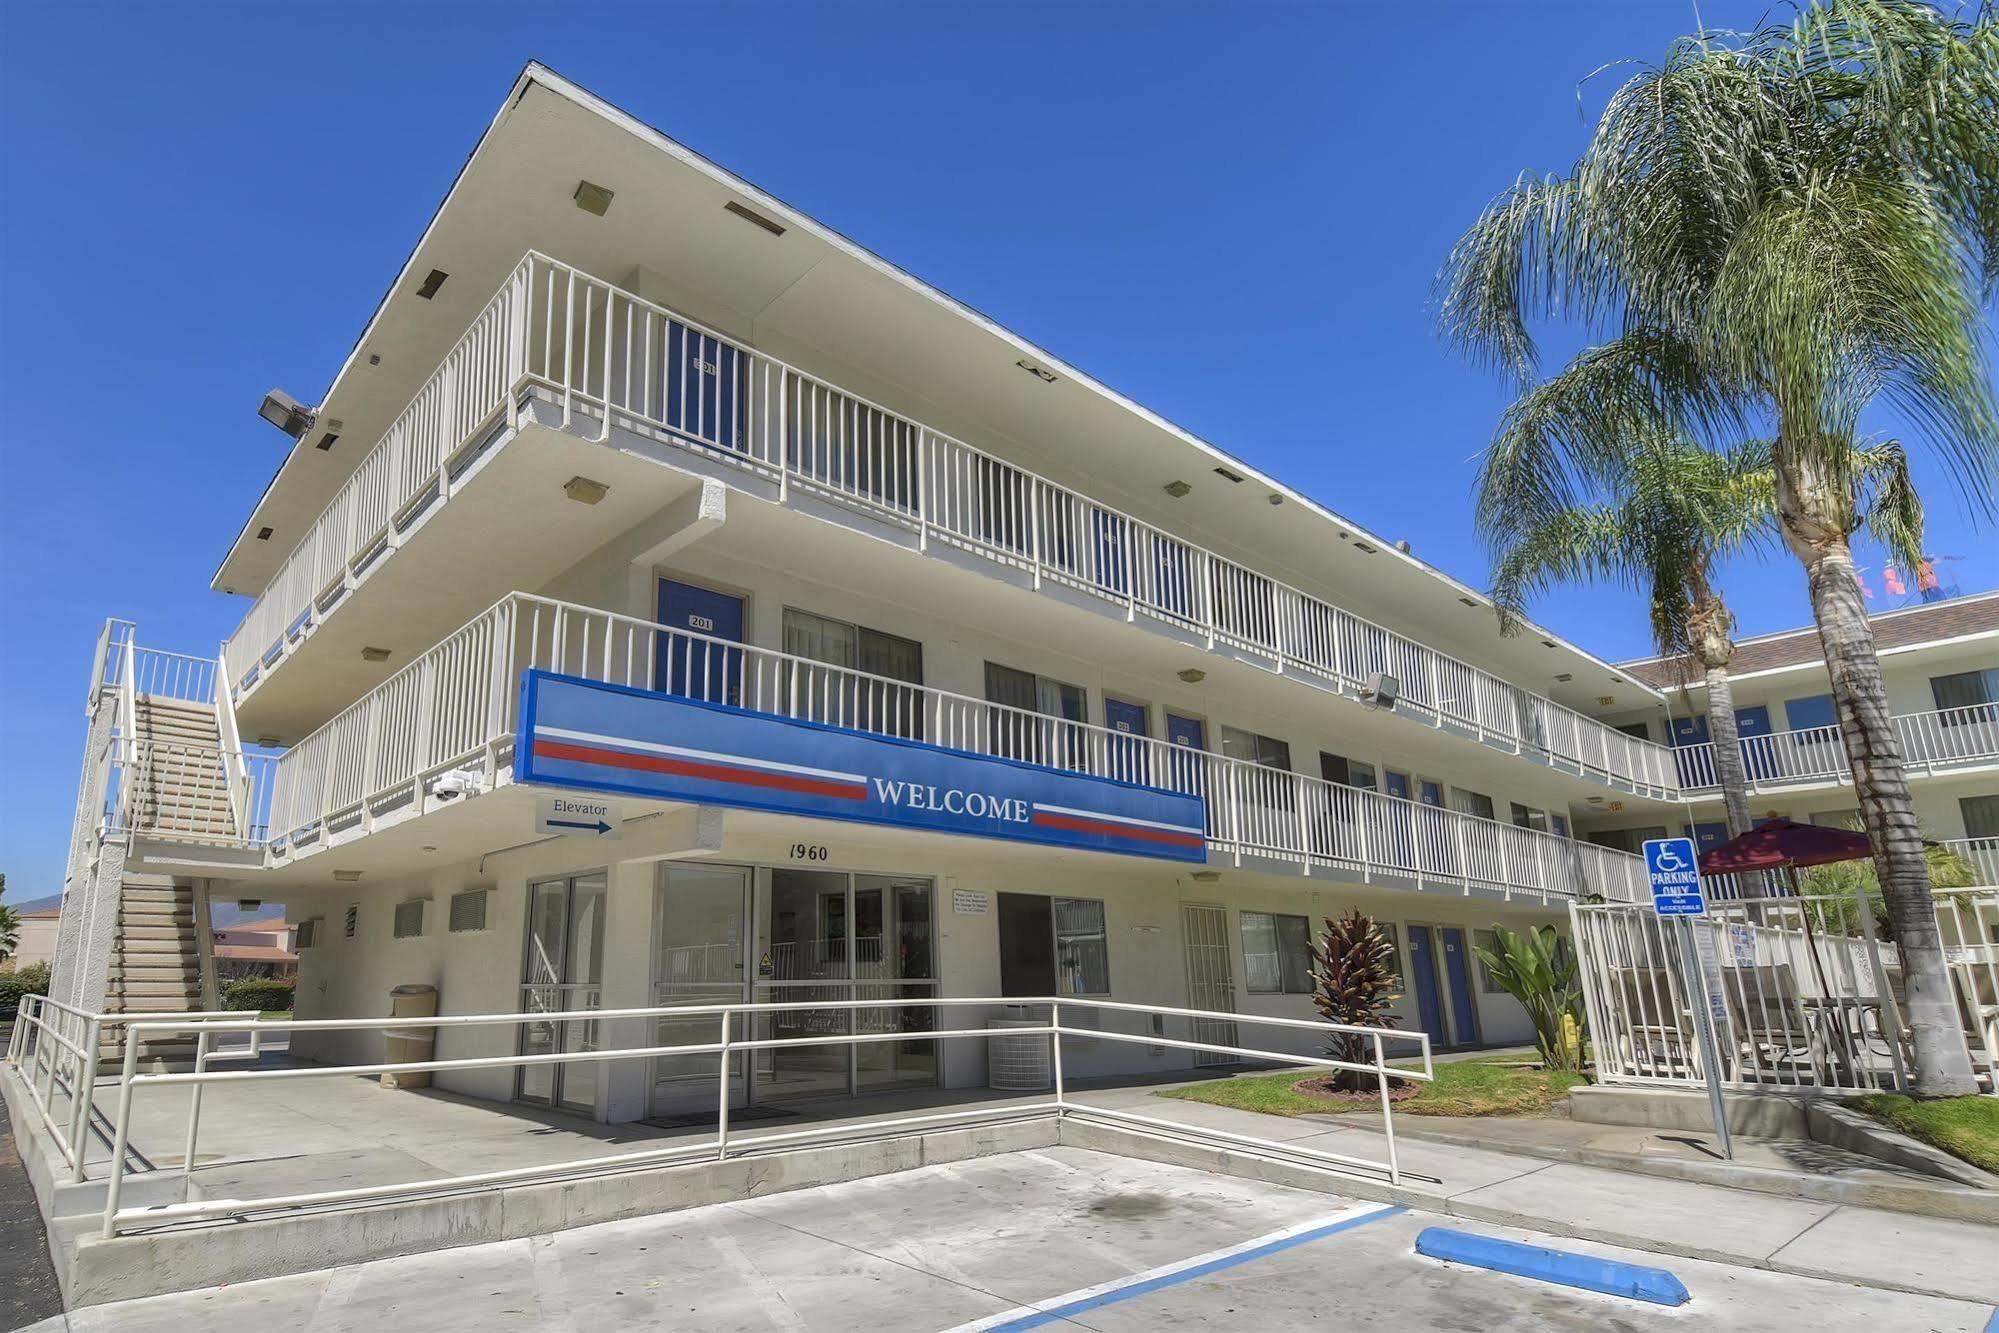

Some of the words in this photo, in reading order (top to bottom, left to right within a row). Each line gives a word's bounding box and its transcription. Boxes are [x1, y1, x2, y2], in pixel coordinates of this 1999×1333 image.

[692, 617, 710, 628] 201
[873, 777, 1030, 823] WELCOME
[554, 800, 607, 815] Elevator
[790, 844, 828, 861] 1960
[1651, 871, 1696, 885] PARKING
[1662, 885, 1690, 895] ONLY
